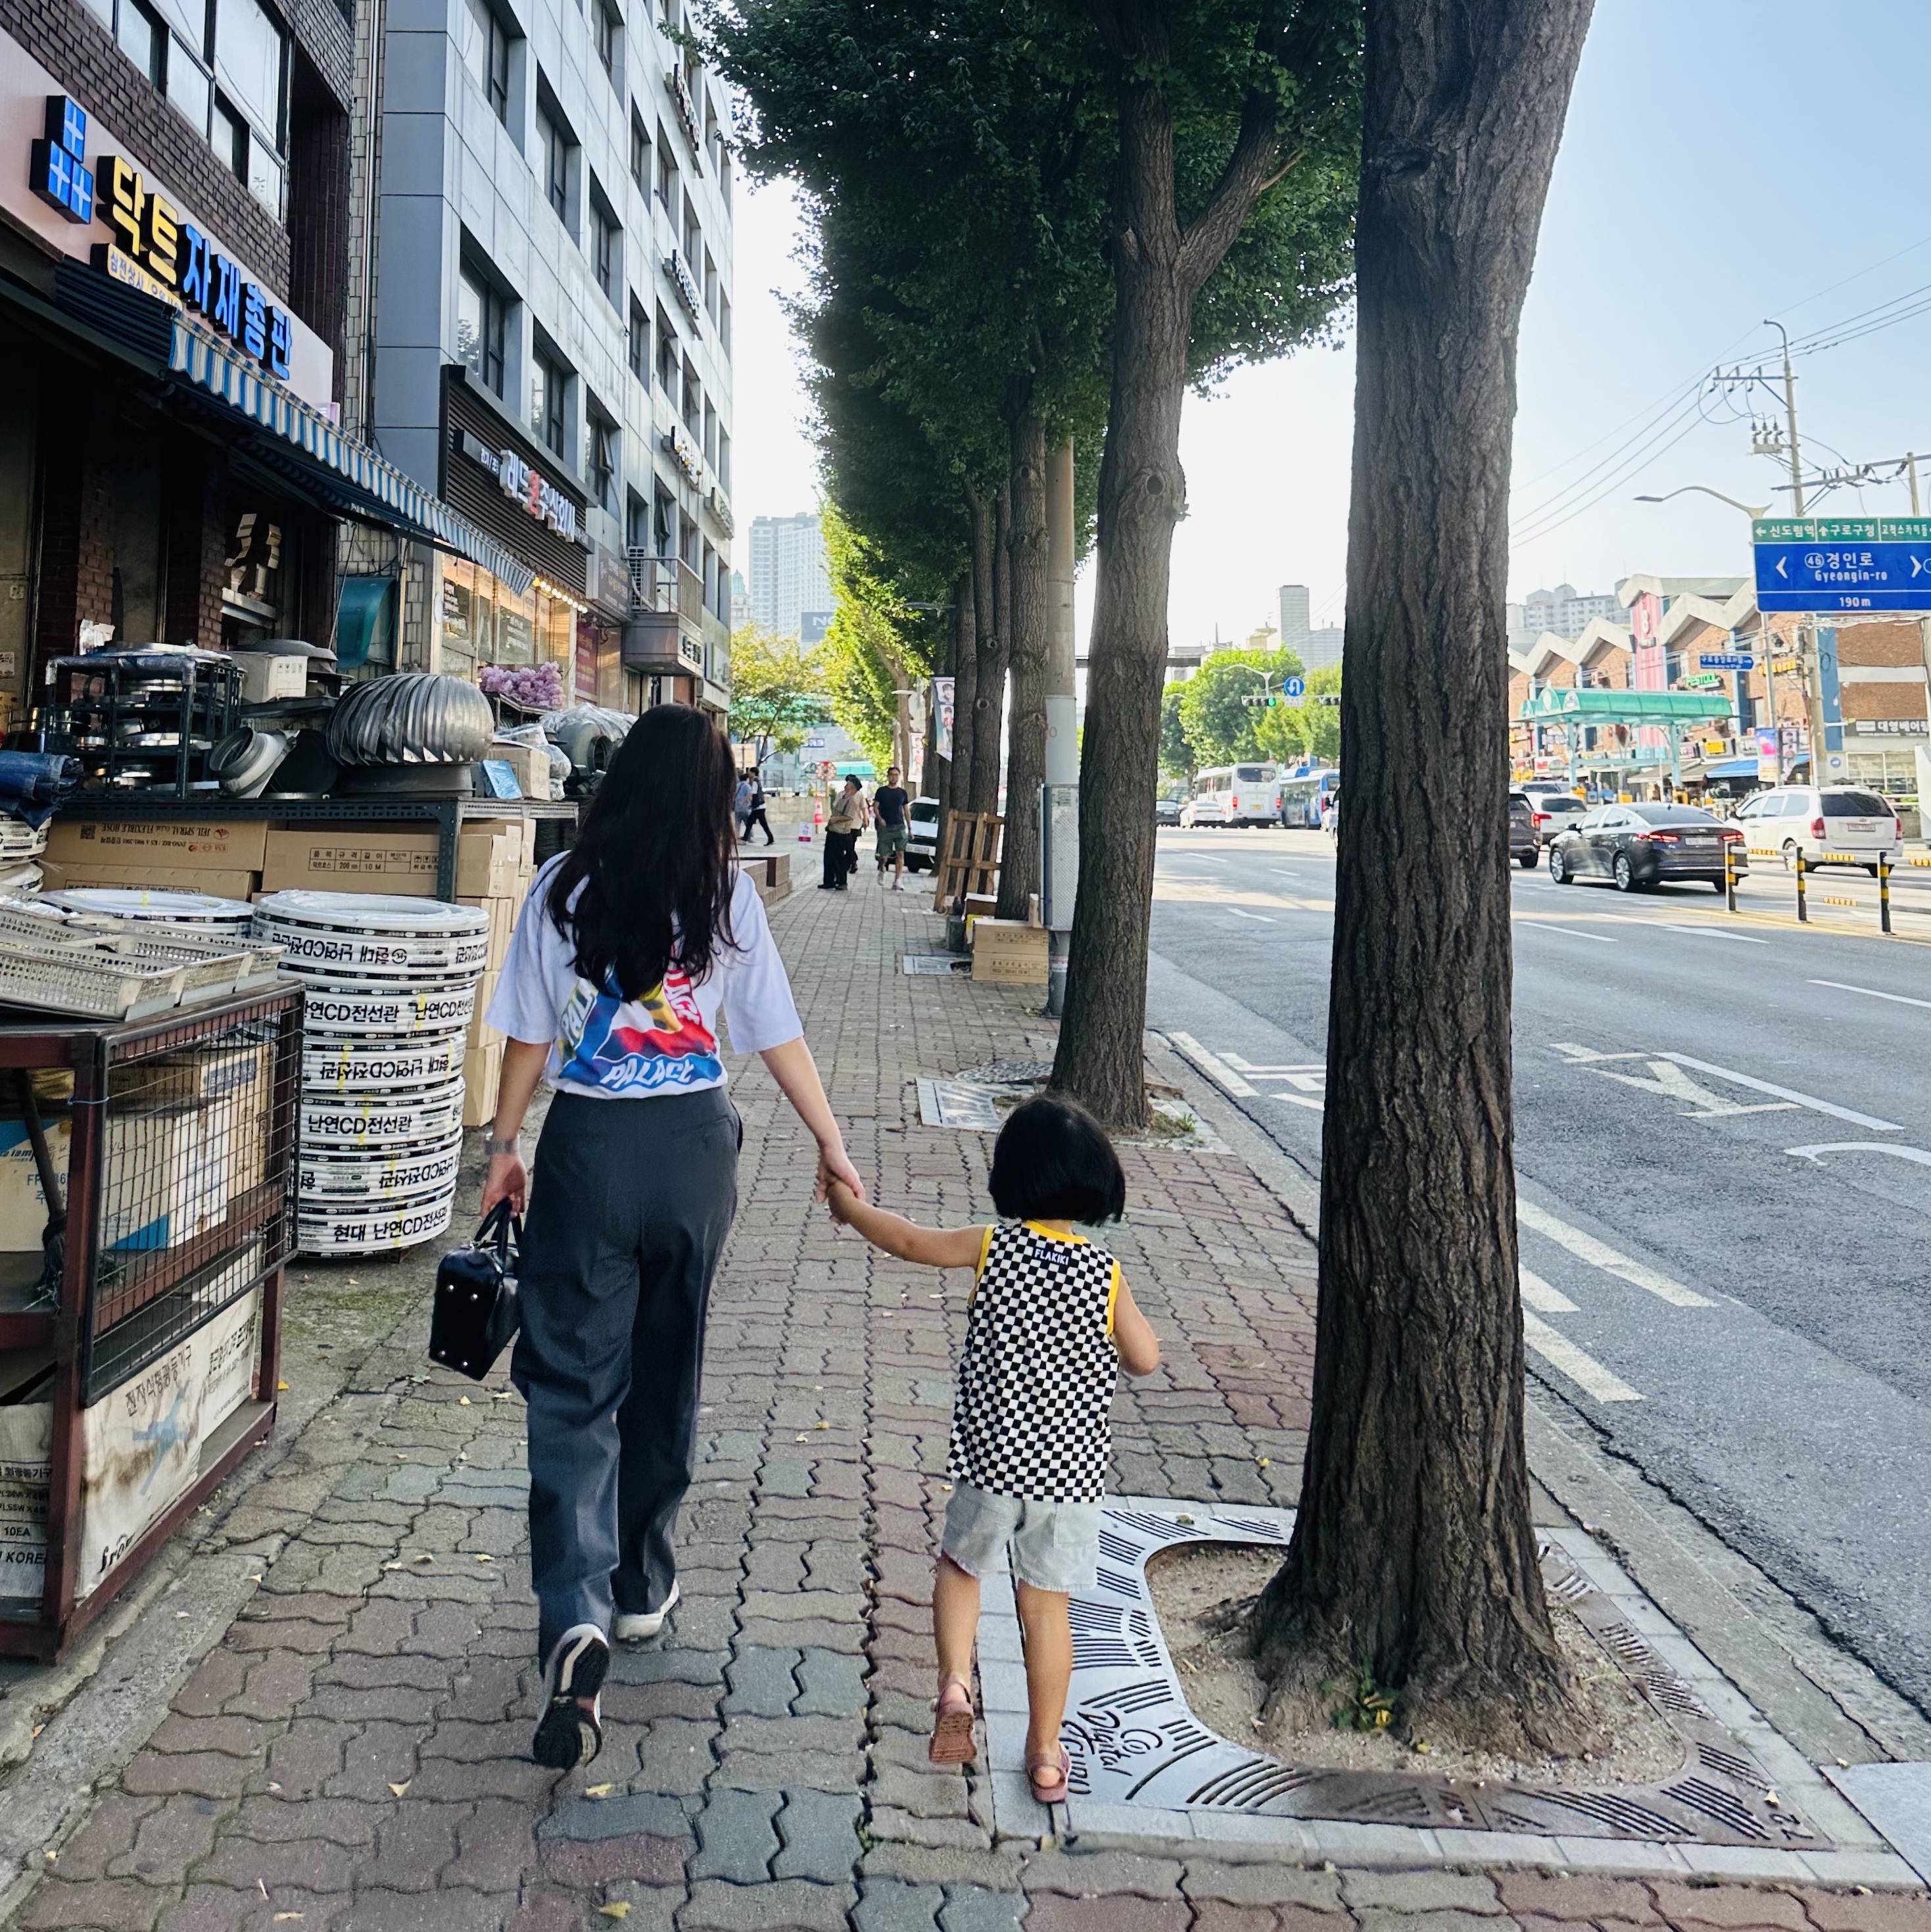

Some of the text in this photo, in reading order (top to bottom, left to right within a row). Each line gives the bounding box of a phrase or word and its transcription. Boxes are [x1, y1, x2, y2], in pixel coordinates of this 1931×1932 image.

[1769, 524, 1815, 538] 신도림역
[1830, 524, 1874, 537] 구로구청
[1807, 552, 1874, 569] 46 경인로
[1815, 569, 1888, 583] Gyeongin-ro
[102, 823, 120, 832] HOSE
[121, 824, 153, 834] FLEXIBLE
[172, 827, 195, 836] SPIRAL
[360, 945, 389, 965] 현대
[320, 1058, 422, 1080] 난연CD전선관
[308, 1114, 412, 1135] 난연CD전선관
[379, 1155, 454, 1190] 난연CD전선관
[333, 1223, 366, 1243] 현대
[373, 1206, 448, 1241] 난연CD전선관
[1034, 1249, 1069, 1266] FLAKIKI
[4, 1526, 31, 1536] 10EA
